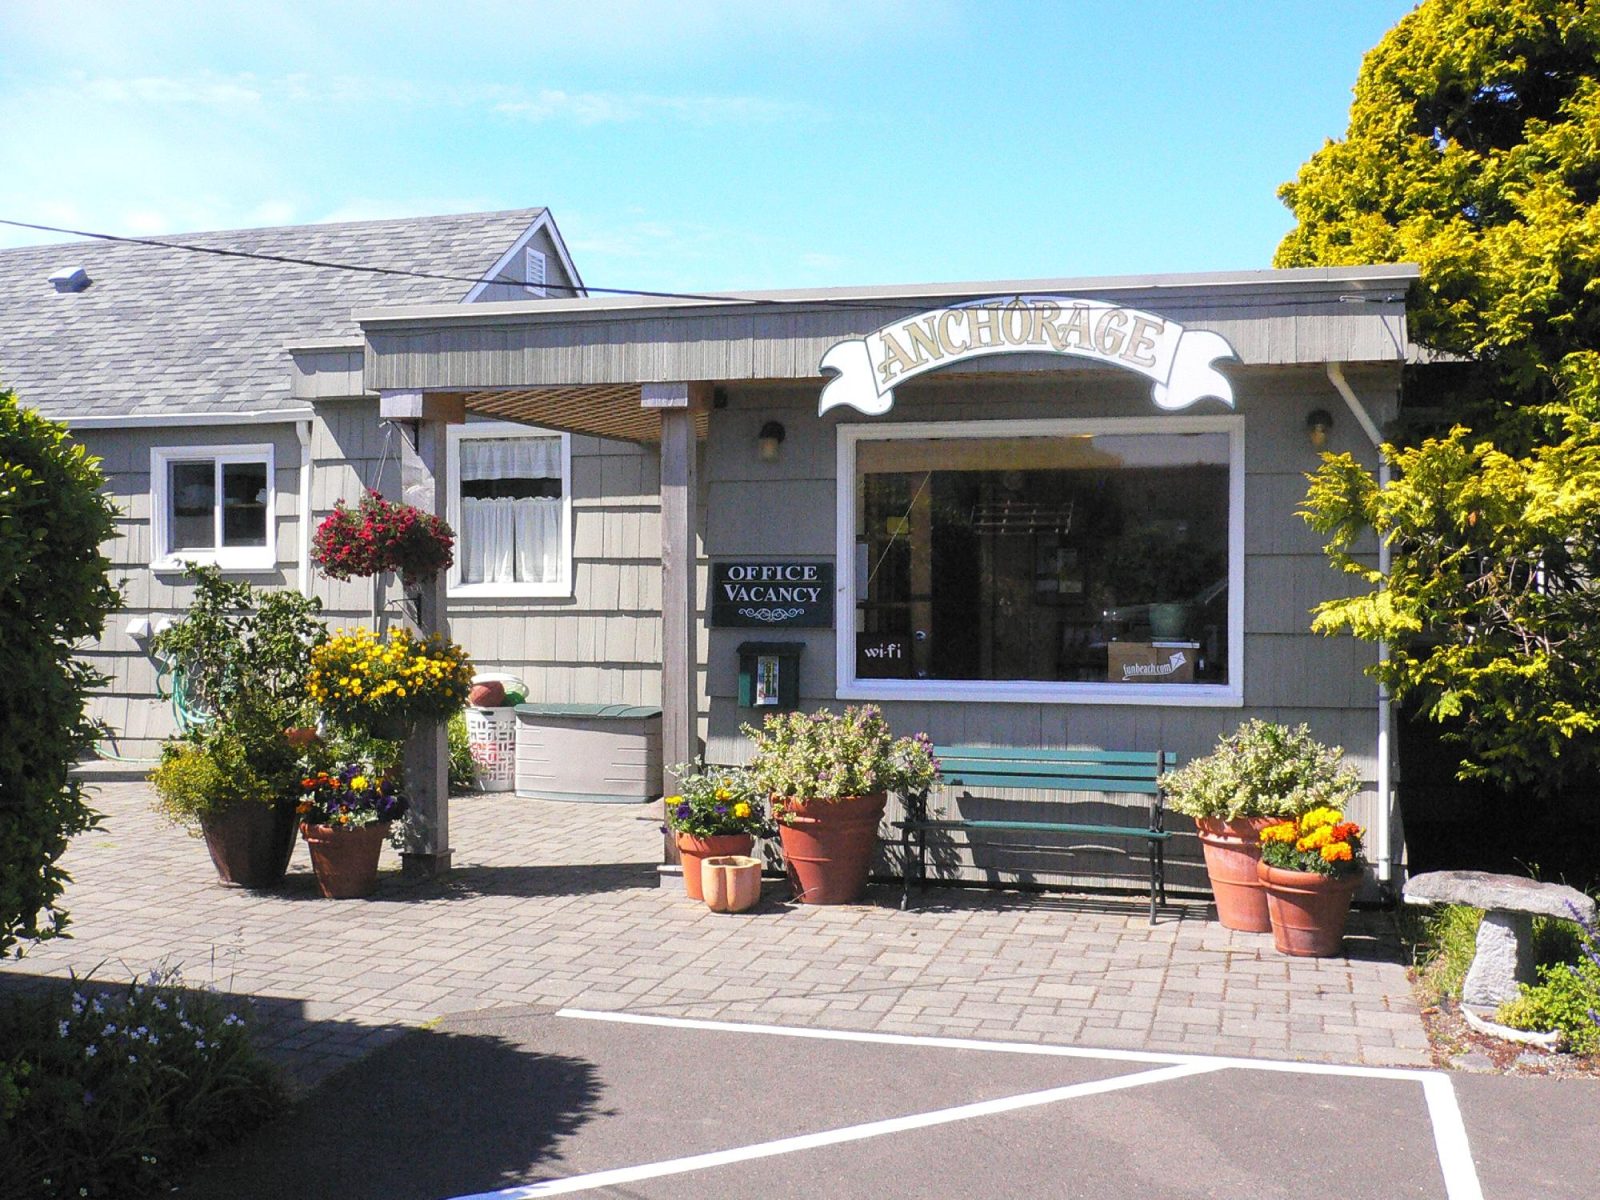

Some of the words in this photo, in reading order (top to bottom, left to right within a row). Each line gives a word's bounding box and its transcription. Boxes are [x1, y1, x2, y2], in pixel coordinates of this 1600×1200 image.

[878, 298, 1168, 382] ANCHORAGE
[728, 565, 818, 581] OFFICE
[724, 584, 821, 603] VACANCY
